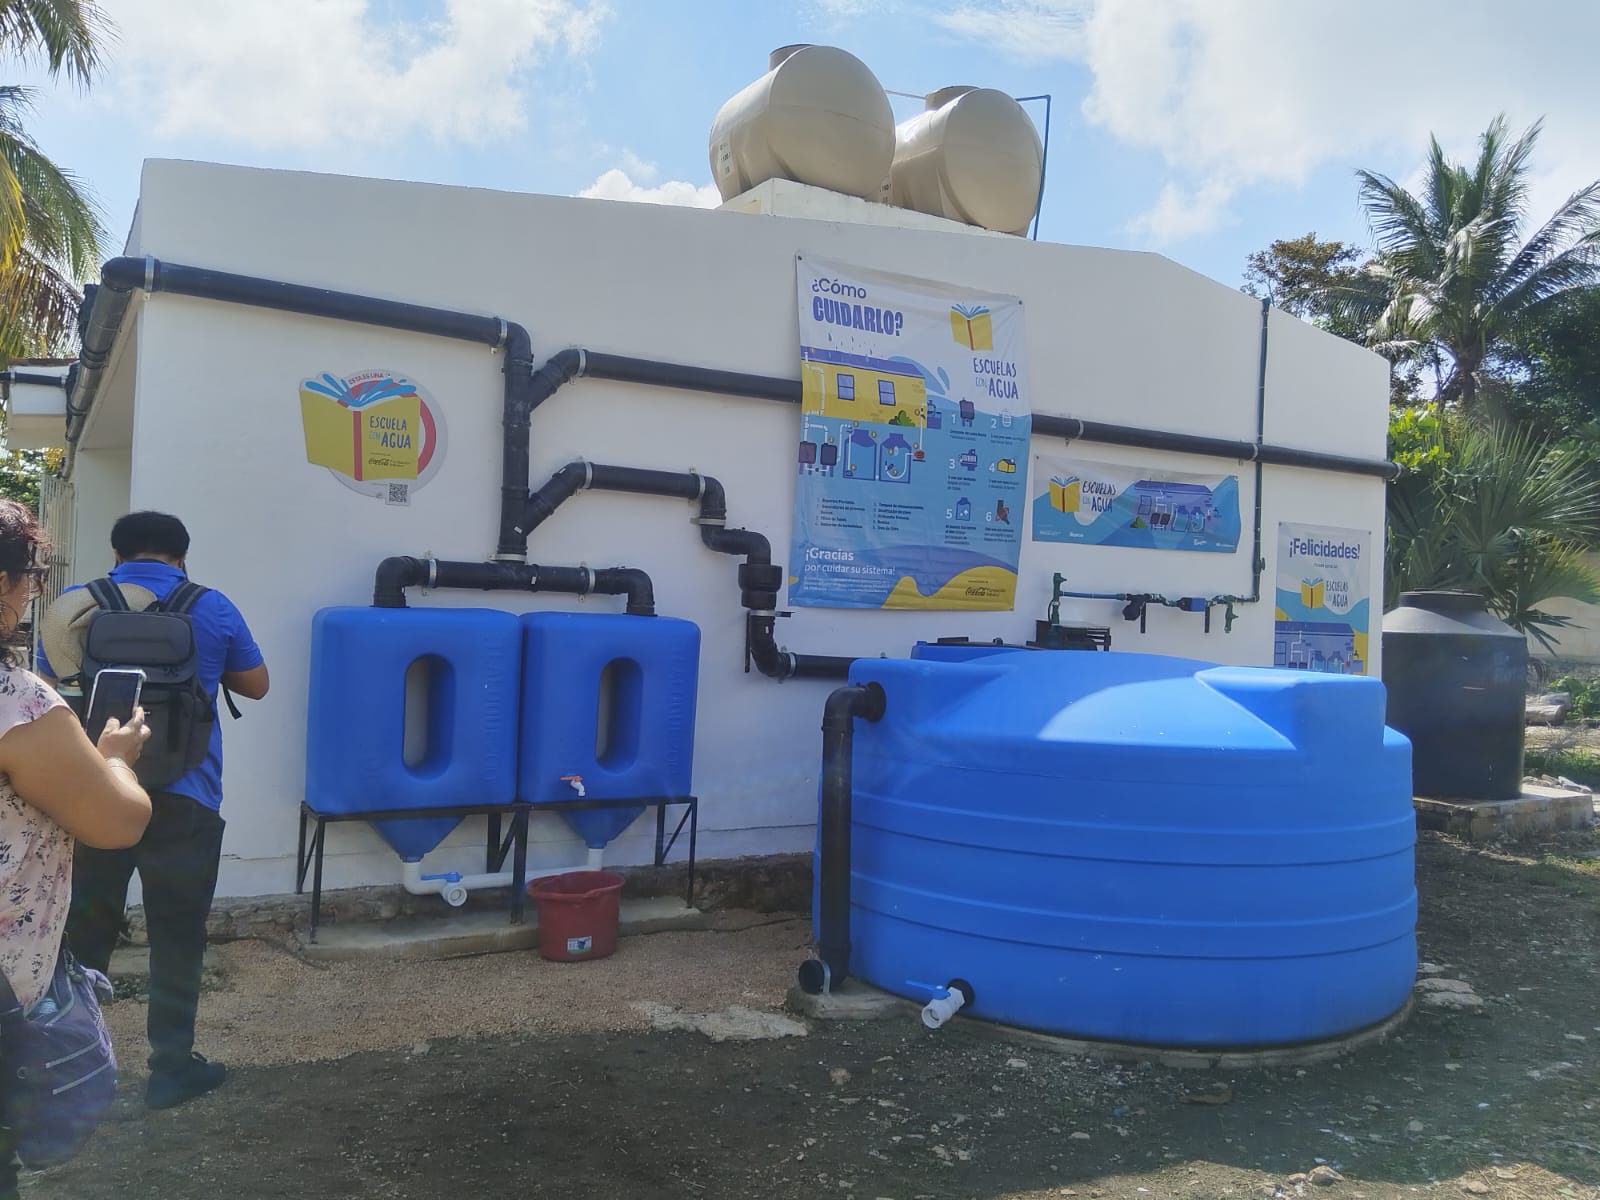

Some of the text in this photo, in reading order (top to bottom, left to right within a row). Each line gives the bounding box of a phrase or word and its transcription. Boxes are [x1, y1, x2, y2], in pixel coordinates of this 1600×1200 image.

[812, 278, 867, 299] ¿Cómo
[812, 295, 904, 337] CUIDARLO?
[973, 357, 1017, 378] ESCUELAS
[988, 377, 1019, 401] AGUA
[369, 415, 407, 431] ESCUELA
[991, 418, 997, 429] 2
[381, 432, 411, 449] AGUA
[948, 458, 956, 470] 3
[988, 463, 995, 473] 4
[1082, 480, 1117, 496] ESCUELAS
[1090, 496, 1113, 513] AGUA
[945, 508, 953, 520] 5
[985, 512, 992, 522] 6
[805, 546, 855, 562] ¡Gracias
[1289, 537, 1361, 560] ¡Felicidades!
[804, 563, 896, 577] por cuidar su sistema!
[1325, 580, 1349, 593] ESCUELAS
[1332, 593, 1348, 608] AGUA
